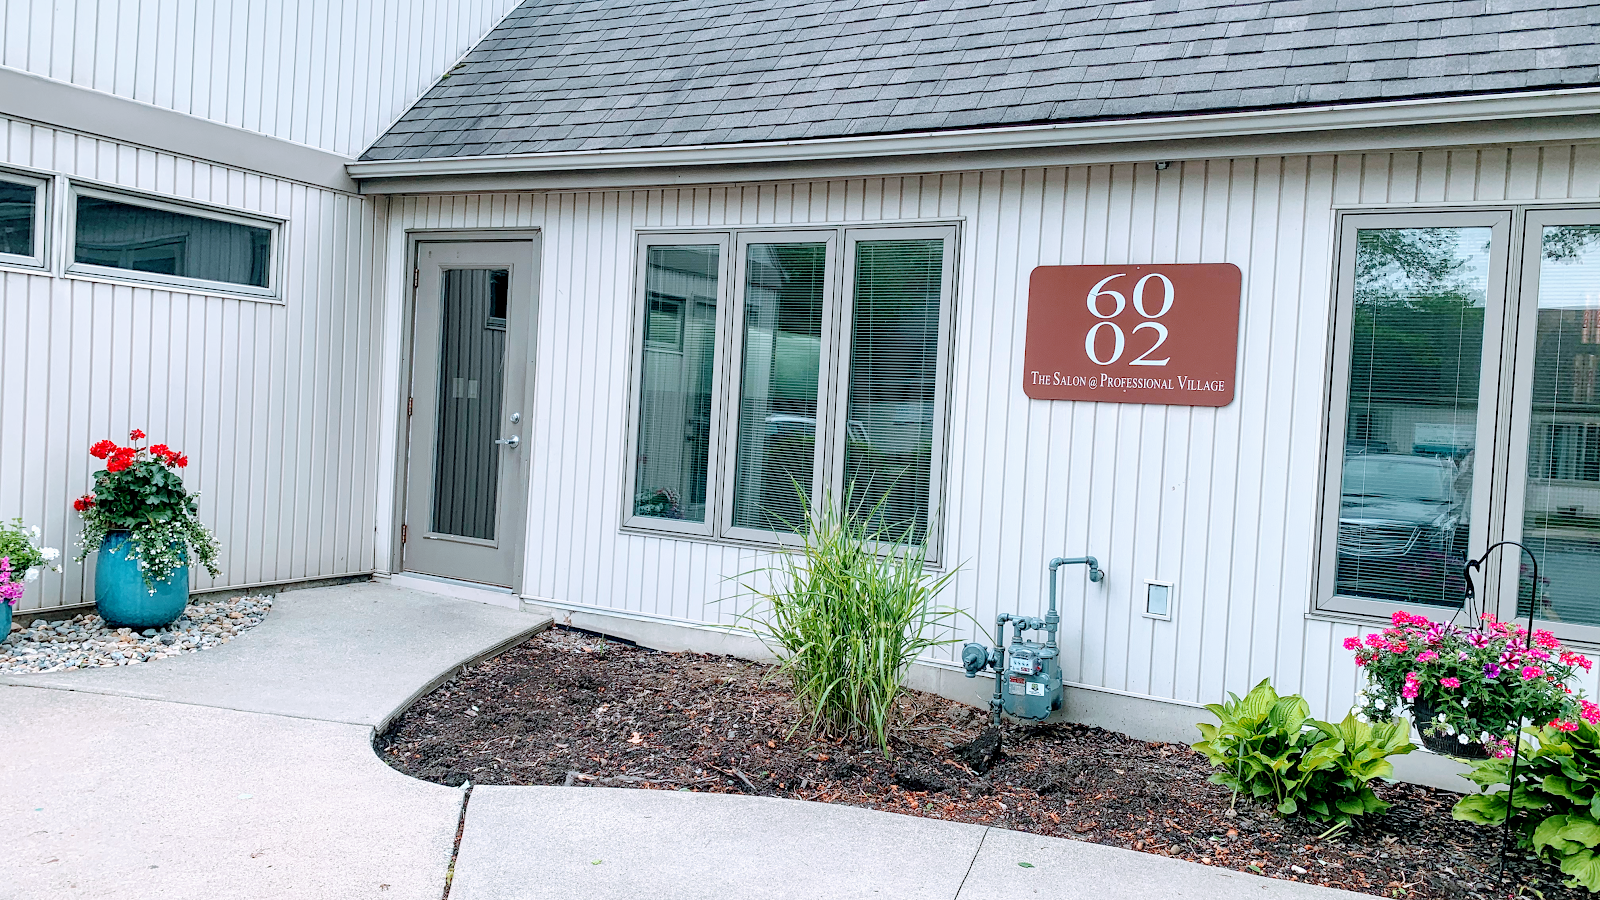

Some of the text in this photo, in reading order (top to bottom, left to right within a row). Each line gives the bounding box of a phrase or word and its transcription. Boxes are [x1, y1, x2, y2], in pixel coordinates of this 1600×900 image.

[1086, 273, 1175, 319] 60
[1085, 321, 1171, 366] 02
[1088, 376, 1098, 390] @
